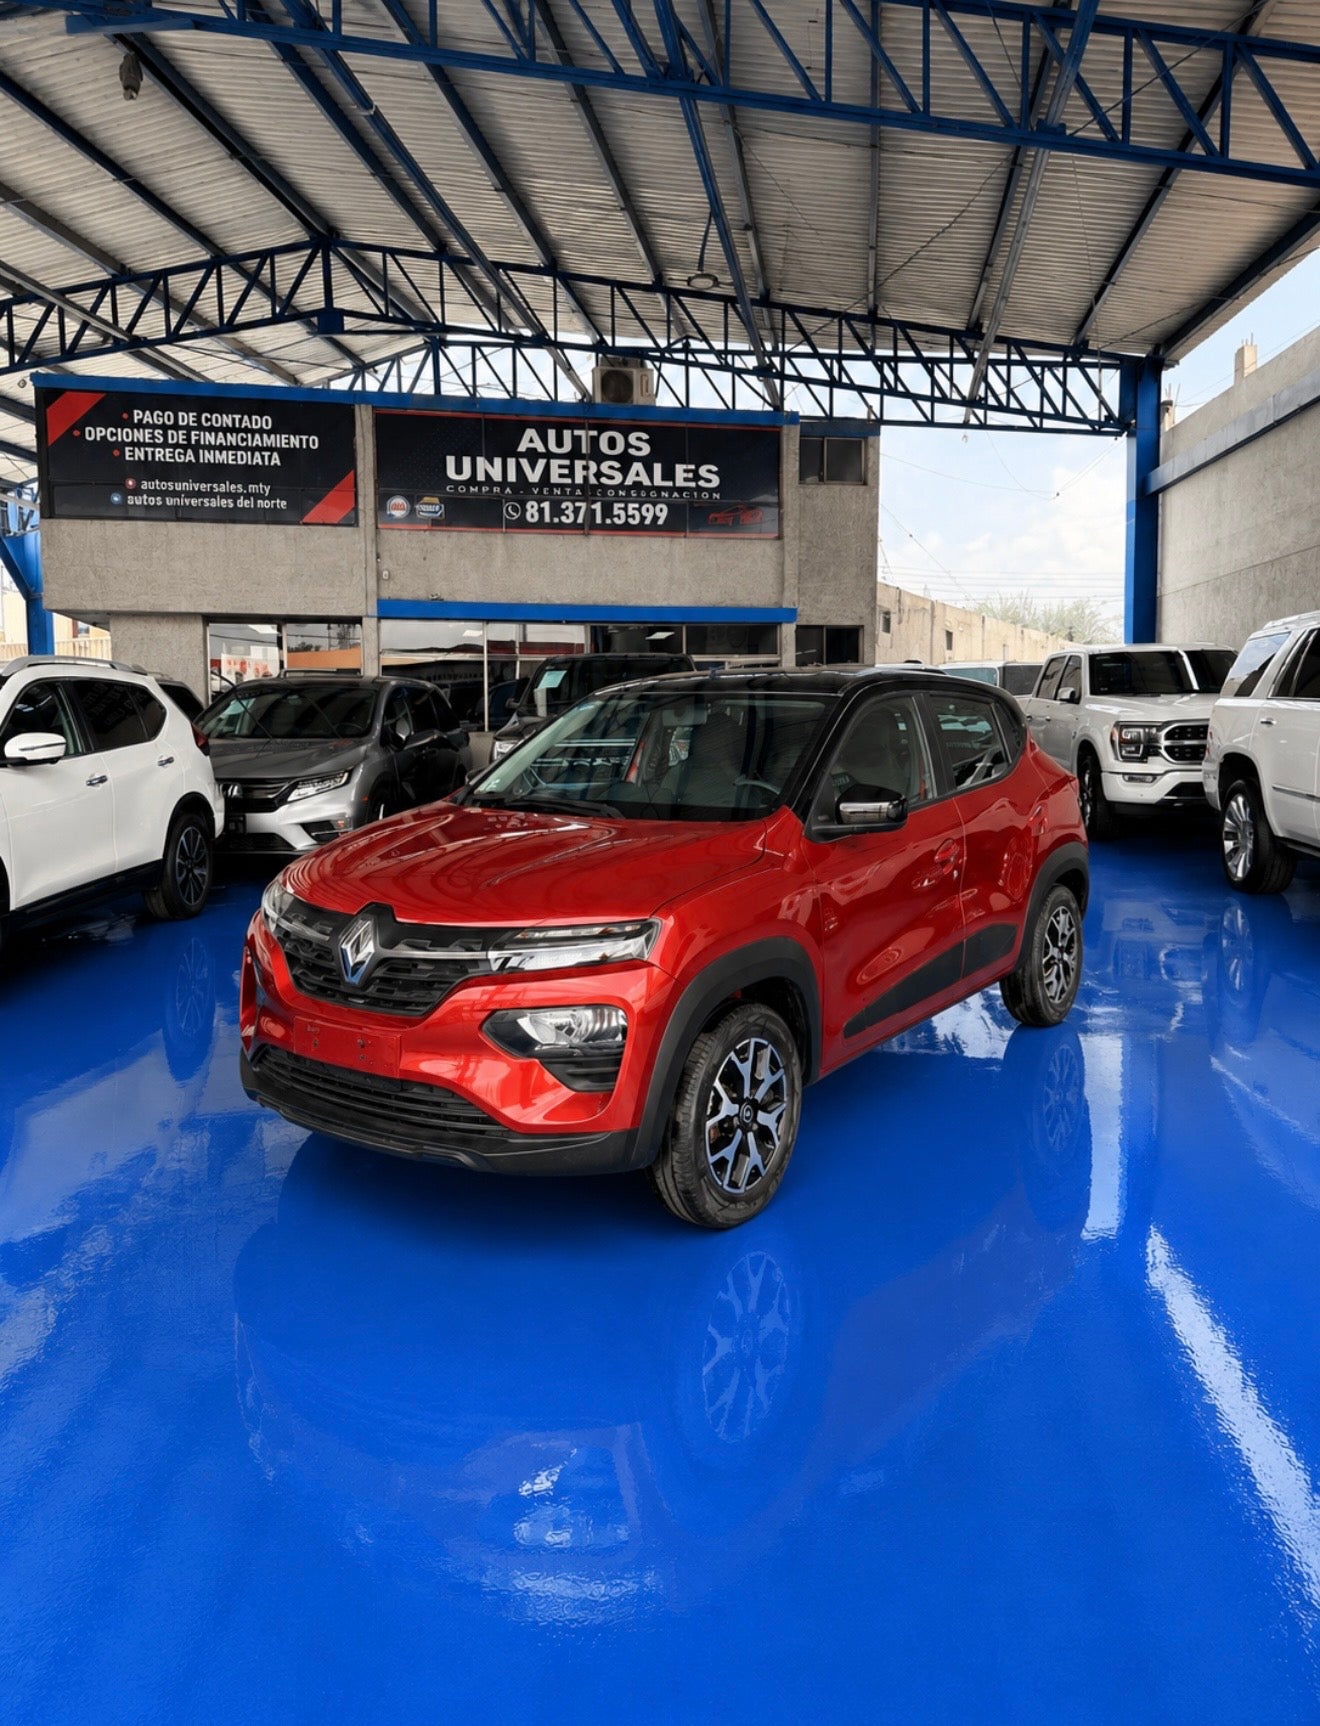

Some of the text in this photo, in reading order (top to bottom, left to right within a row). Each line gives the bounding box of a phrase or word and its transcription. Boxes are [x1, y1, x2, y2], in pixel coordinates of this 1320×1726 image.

[133, 409, 272, 430] PAGO DE CONTADO
[85, 426, 319, 450] OPCIONES DE FINANCIAMIENTO
[517, 428, 651, 457] AUTOS
[125, 446, 281, 466] ENTREGA INMEDIATA
[446, 455, 720, 488] UNIVERSALES
[141, 479, 271, 496] autosuniversales.mty
[446, 485, 512, 495] COMPRA
[532, 487, 582, 496] VENTA
[127, 494, 287, 509] autos universales del norte
[526, 500, 668, 525] 81.371.5599
